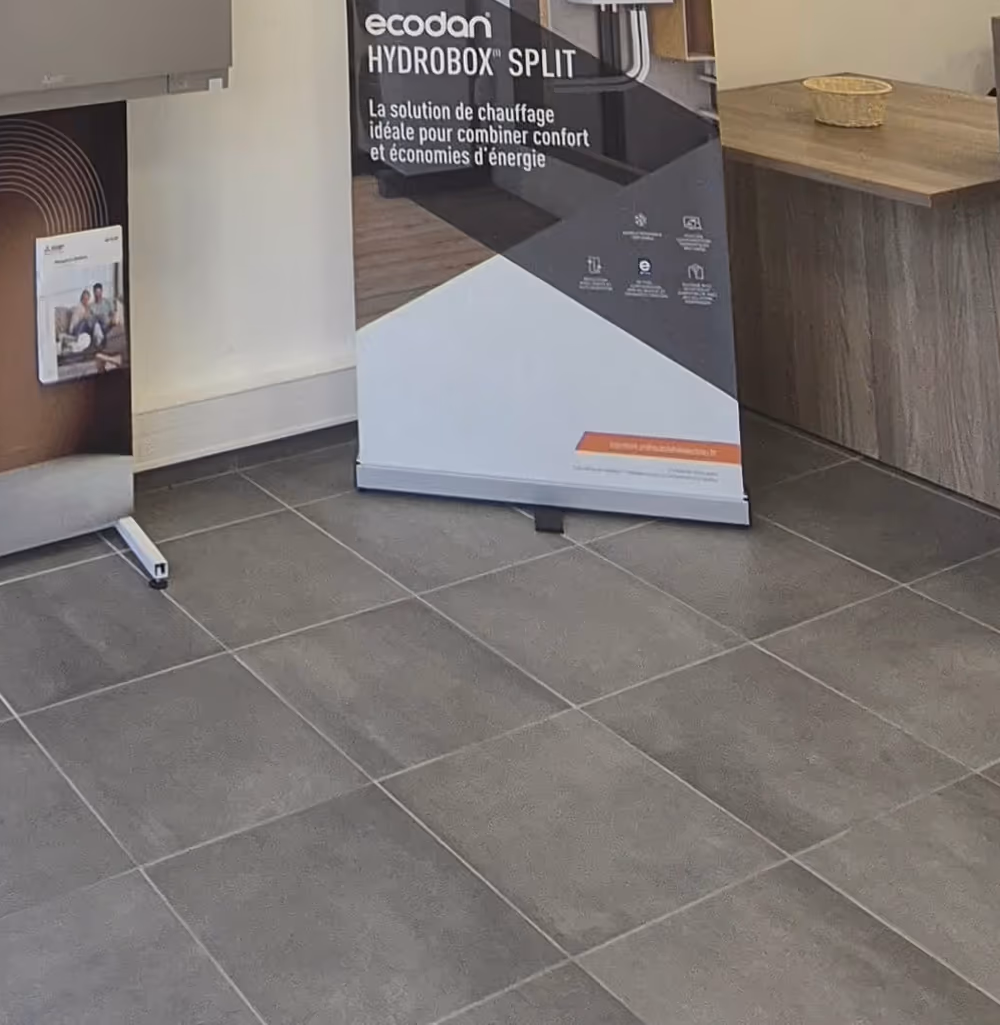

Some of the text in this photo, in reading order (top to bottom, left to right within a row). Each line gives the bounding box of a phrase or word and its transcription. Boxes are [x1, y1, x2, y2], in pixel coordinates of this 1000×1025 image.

[365, 11, 492, 39] ecodan
[367, 44, 494, 77] HYDROBOX
[508, 47, 577, 79] SPLIT
[369, 98, 555, 127] La solution de chauffage
[369, 120, 590, 147] idéale pour combiner confort
[370, 142, 546, 172] et économies d'énergie
